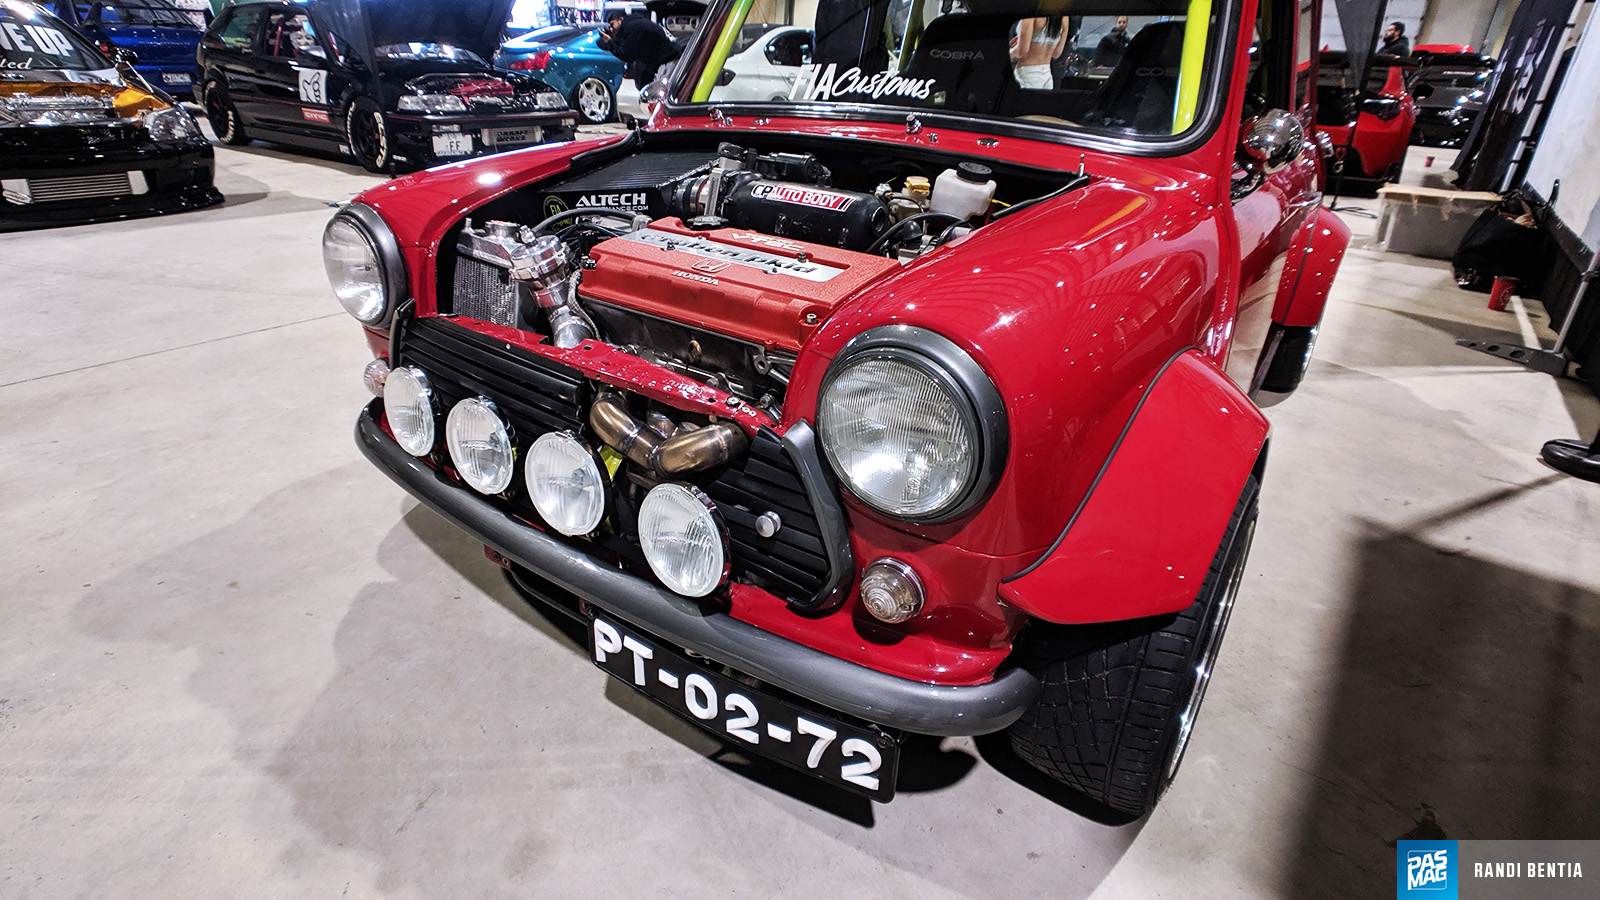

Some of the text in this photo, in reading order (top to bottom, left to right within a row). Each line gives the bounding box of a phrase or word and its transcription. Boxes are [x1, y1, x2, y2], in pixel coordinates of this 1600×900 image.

[23, 25, 74, 57] UP
[929, 48, 985, 61] COBRA
[1135, 66, 1178, 77] COB
[575, 193, 647, 207] ALTECH
[802, 190, 839, 207] BODY
[671, 270, 719, 286] HONDA
[593, 617, 882, 791] PT-02-72
